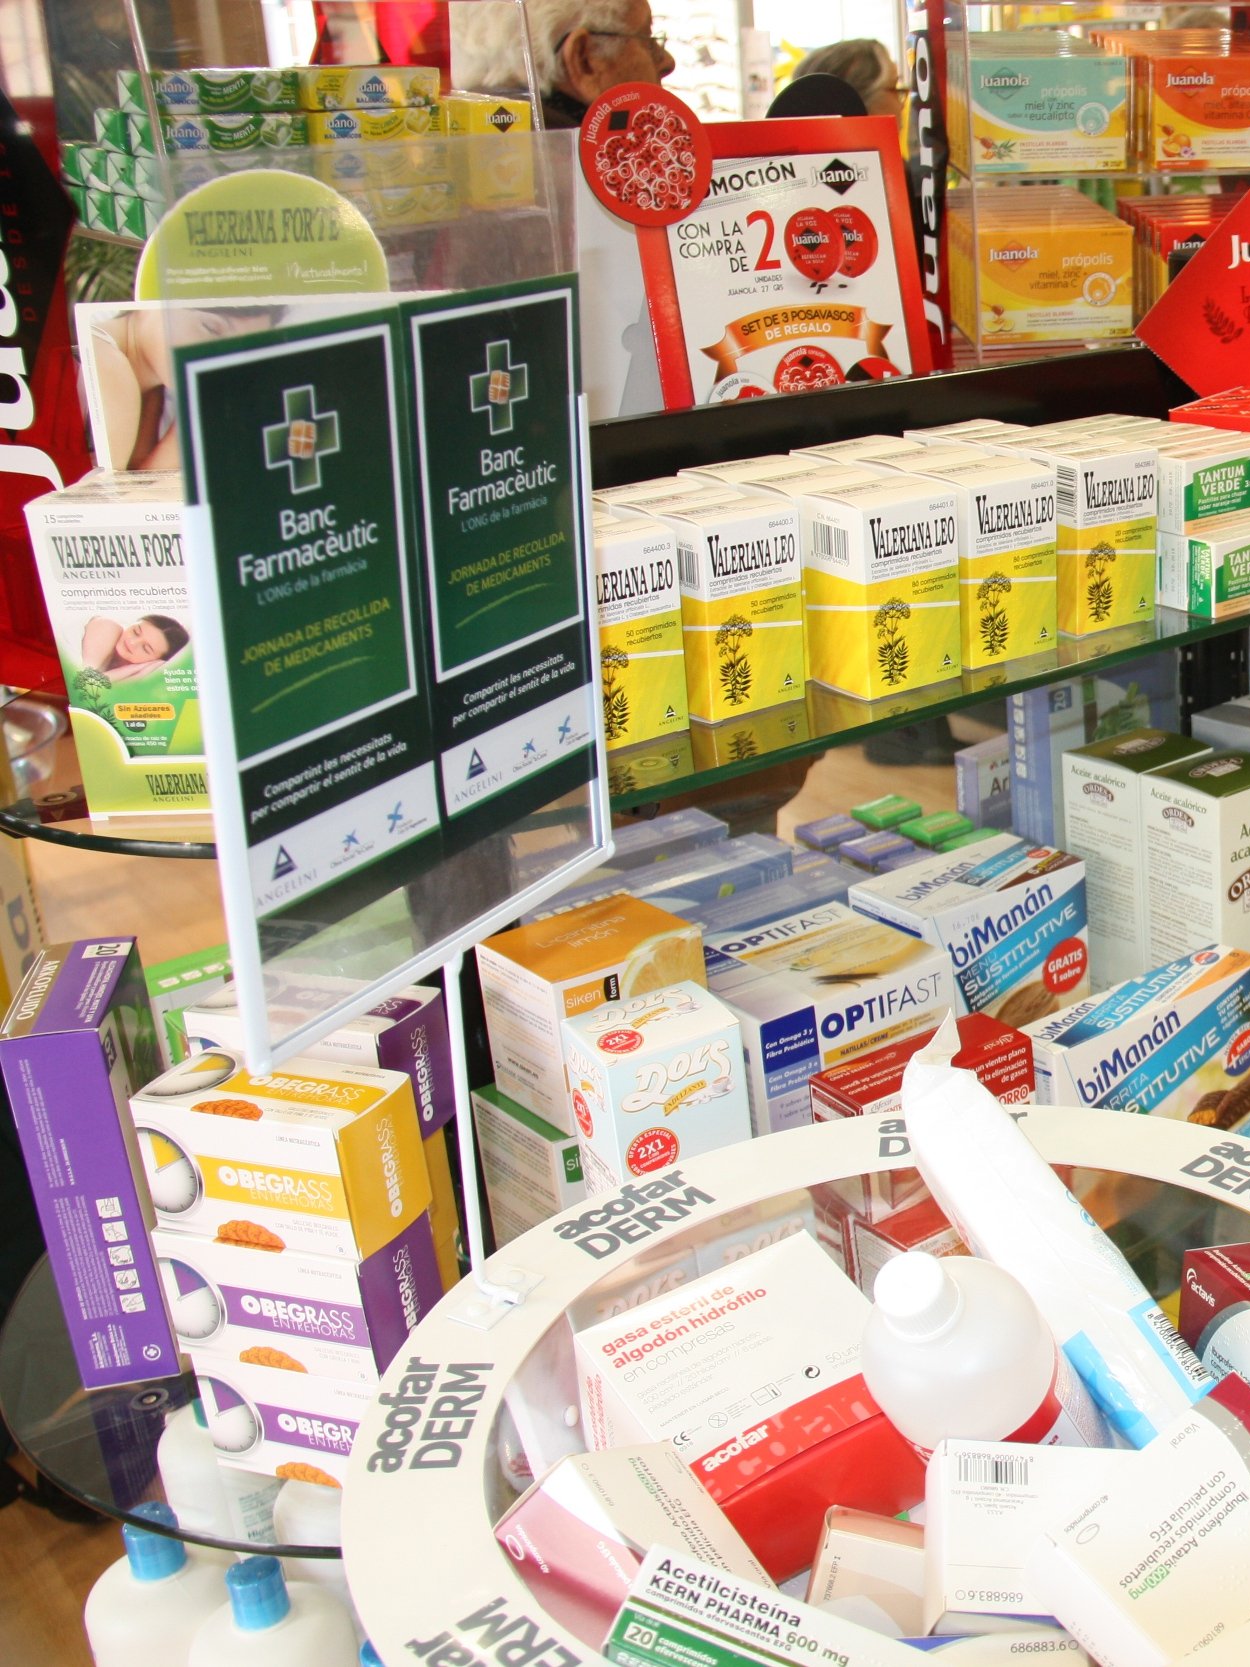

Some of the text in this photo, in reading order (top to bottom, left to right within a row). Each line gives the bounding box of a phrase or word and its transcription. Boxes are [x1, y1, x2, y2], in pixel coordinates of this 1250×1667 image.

[979, 73, 1030, 89] Juanola
[1040, 85, 1087, 98] própolis
[1166, 72, 1215, 88] Juanola
[583, 91, 640, 144] juanola corazón
[1029, 109, 1074, 122] eucalipto
[810, 164, 868, 187] Juanola
[184, 206, 341, 246] VALERIANA FORTE
[677, 209, 782, 272] CON LA 2
[792, 231, 830, 247] Juanola
[679, 239, 746, 258] COMPRA
[730, 256, 750, 273] DE
[989, 245, 1039, 262] Juanola
[1062, 252, 1113, 268] própolis
[741, 307, 856, 336] SET DE 3 POSAVASOS
[765, 323, 831, 341] DE REGALO
[480, 446, 524, 476] Banc
[1199, 464, 1245, 482] TANTUM
[448, 461, 557, 515] Farmacèutic
[1083, 471, 1155, 510] VALERIANA LEO
[1201, 480, 1241, 497] VERDE
[279, 504, 337, 541] Banc
[975, 494, 1055, 535] VALERIANA LEO
[51, 533, 186, 569] VALERIANA FORT
[238, 520, 379, 586] Farmacèutic
[869, 516, 955, 560] VALERIANA LEO
[975, 526, 1042, 545] comprimidos recubiertos
[448, 531, 566, 585] JORNADA DE RECOLLIDA
[707, 533, 796, 578] VALERIANA LEO
[1013, 559, 1043, 572] recubiertos
[61, 585, 188, 599] comprimidos recubiertos
[466, 554, 551, 596] DE MEDICAMENTS
[912, 583, 944, 596] recubiertos
[240, 597, 391, 664] JORNADA DE RECOLLIDA
[626, 620, 677, 638] 50 comprimidos
[626, 632, 663, 646] recubiertos
[264, 624, 374, 677] DE MEDICAMENTS
[463, 653, 564, 706] Compartint les necessitats
[263, 732, 393, 798] Compartint les necessitats
[1070, 764, 1126, 789] Aceite acalórico
[146, 773, 208, 795] VALERIANA
[454, 771, 504, 803] ANGELINI
[1150, 787, 1207, 814] Aceite acalórico
[256, 868, 318, 907] ANGELINI
[896, 861, 976, 902] biManán
[568, 927, 620, 949] limón
[720, 907, 844, 952] OPTIFAST
[947, 883, 1054, 969] biManán
[964, 902, 1078, 995] SUSTITUTIVE
[1048, 950, 1083, 973] GRATIS
[16, 960, 60, 1020] ARKOFLUIDO
[566, 976, 617, 1009] siken form
[820, 972, 942, 1039] OPTIFAST
[1097, 962, 1188, 1030] SUSTITUTIVE
[1034, 1001, 1097, 1042] biManán
[605, 1034, 629, 1047] 2X1
[1077, 1008, 1181, 1104] biManán
[249, 1075, 366, 1101] OBEGRASS
[411, 1027, 435, 1122] OBEGRASS
[1001, 1067, 1028, 1083] de gases
[664, 1081, 706, 1112] ENDULZANTE
[637, 1138, 665, 1159] 2X1
[217, 1165, 333, 1201] OBEGRASS
[376, 1118, 404, 1218] OBEGRASS
[553, 1169, 685, 1240] acofar
[574, 1186, 718, 1260] DERM
[240, 1294, 354, 1331] OBEGRASS
[1190, 1283, 1215, 1307] actavis
[273, 1315, 356, 1341] ENTREHORAS
[602, 1326, 649, 1356] gasa
[711, 1285, 735, 1303] de
[613, 1287, 767, 1369] algodón hidrófilo
[623, 1320, 736, 1383] en compresas
[366, 1356, 440, 1473] acofar
[408, 1362, 495, 1471] DERM
[701, 1424, 769, 1471] acofar
[1064, 1494, 1109, 1533] 40 comprimidos
[1149, 1470, 1226, 1541] con película EFG
[1199, 1491, 1249, 1538] Ibuprofeno
[1119, 1480, 1237, 1589] comprimidos recubiertos
[657, 1558, 802, 1629] Acetilcisteína
[966, 1589, 1024, 1603] 686883.6
[626, 1626, 655, 1647] 20
[644, 1586, 793, 1653] comprimidos efervescentes EFG
[650, 1575, 851, 1667] KERN PHARMA 600 mg
[658, 1636, 718, 1666] comprimidos
[1010, 1640, 1067, 1654] 686883.6
